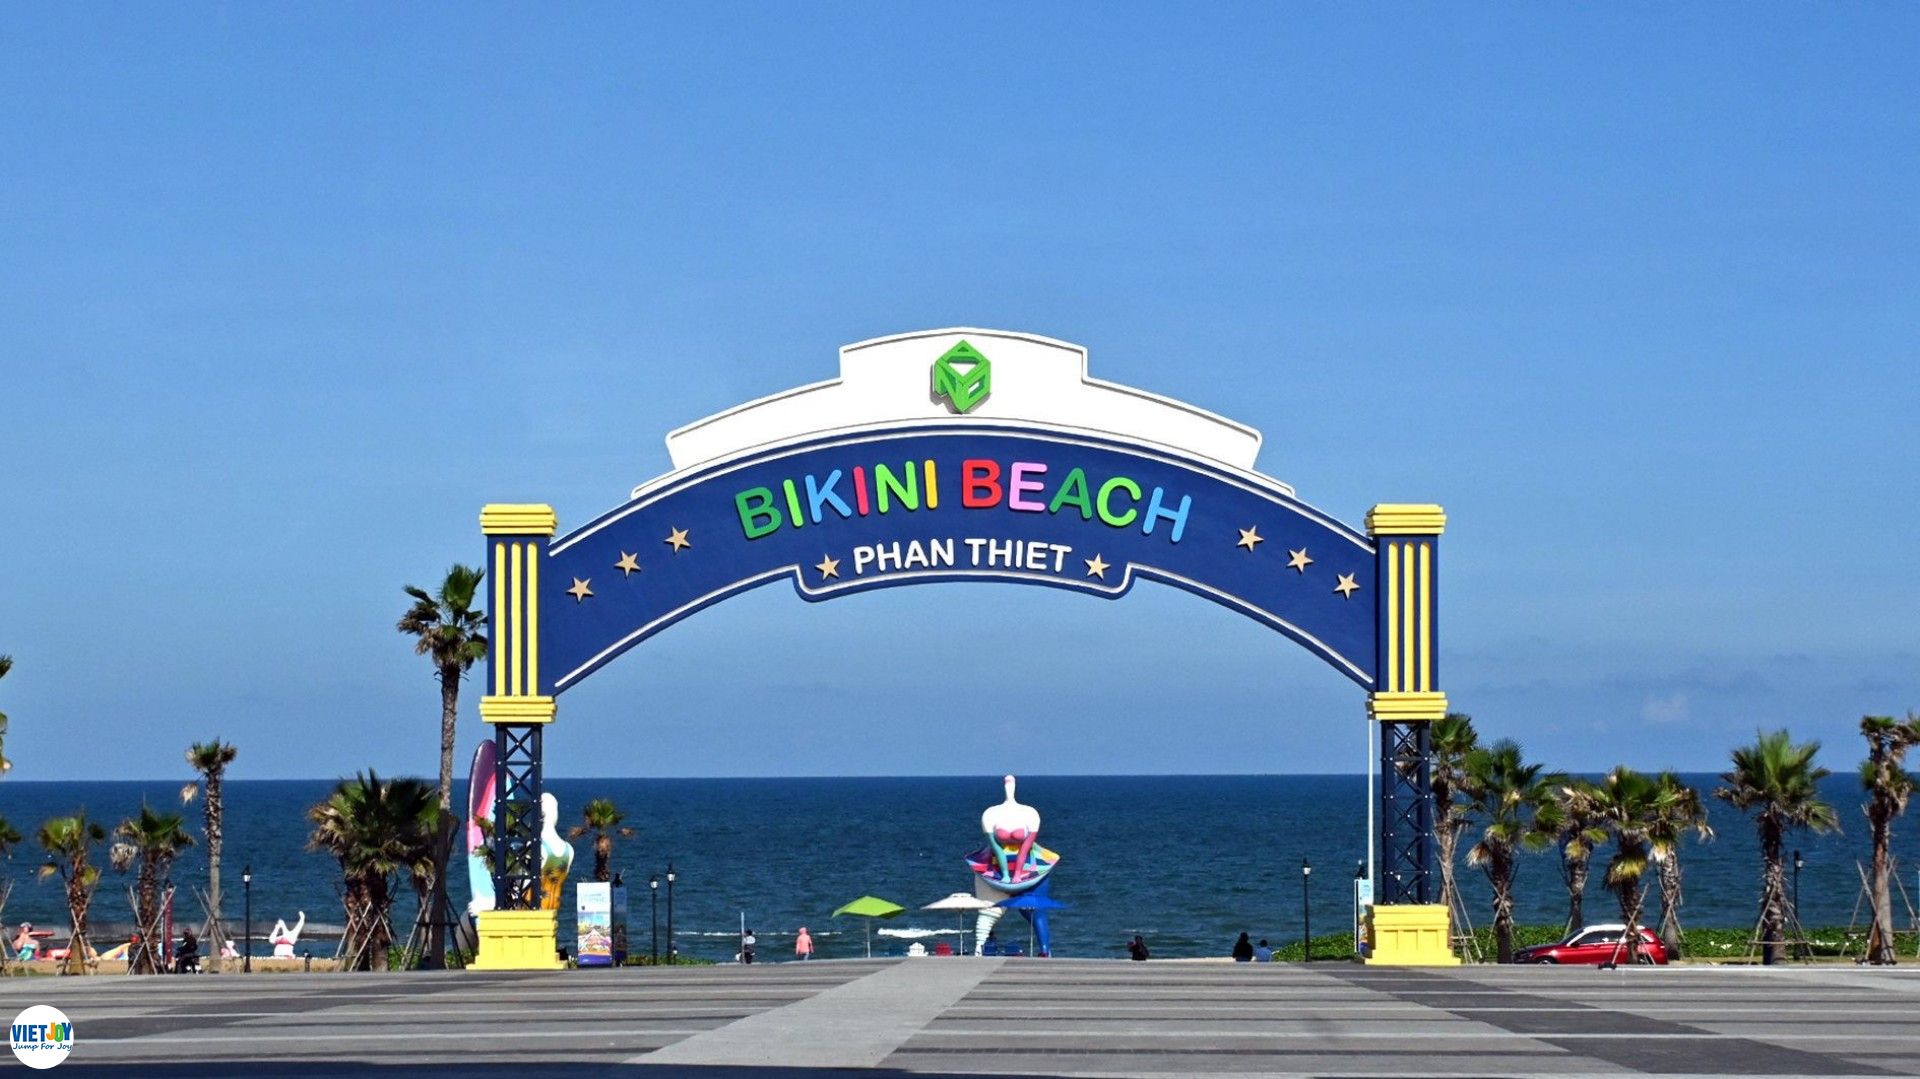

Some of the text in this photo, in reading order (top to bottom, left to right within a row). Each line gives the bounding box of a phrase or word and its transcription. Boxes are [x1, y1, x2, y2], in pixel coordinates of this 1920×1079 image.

[735, 459, 1192, 542] BIKINI BEACH
[853, 538, 1072, 574] PHAN THIET
